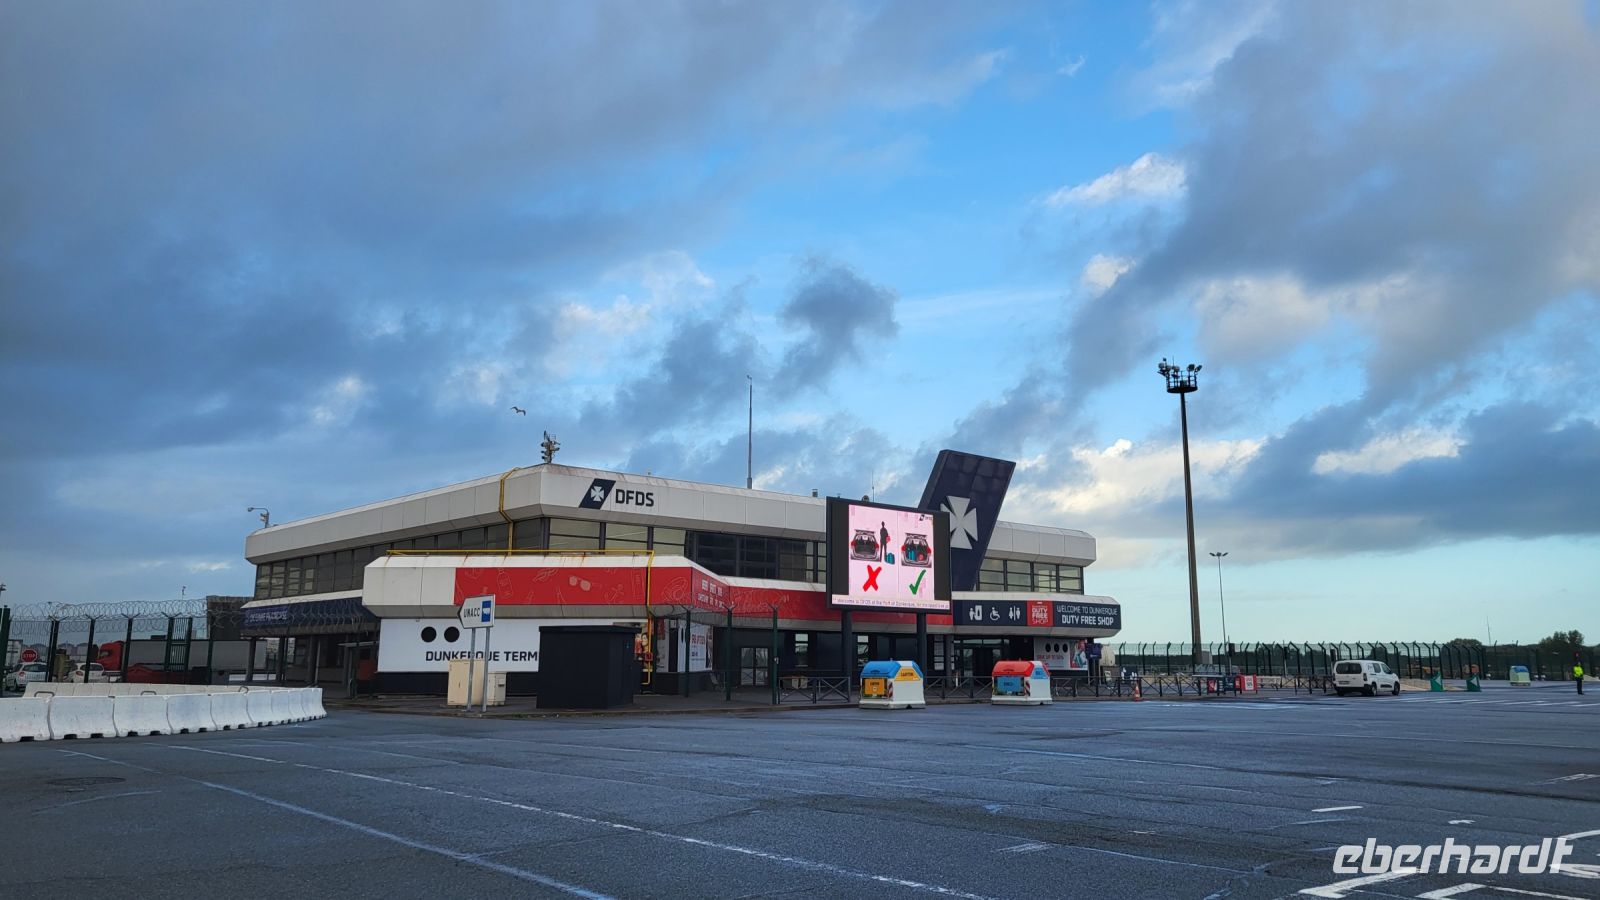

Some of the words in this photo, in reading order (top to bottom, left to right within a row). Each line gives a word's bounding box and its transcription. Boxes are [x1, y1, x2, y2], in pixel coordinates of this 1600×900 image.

[615, 489, 655, 507] DFDS
[1056, 605, 1081, 614] WELCOME
[1090, 607, 1118, 616] DUNKERQUE
[1062, 614, 1079, 624] DUTY
[1080, 616, 1096, 624] FREE
[1097, 616, 1114, 626] SHOP
[504, 651, 538, 661] TERM
